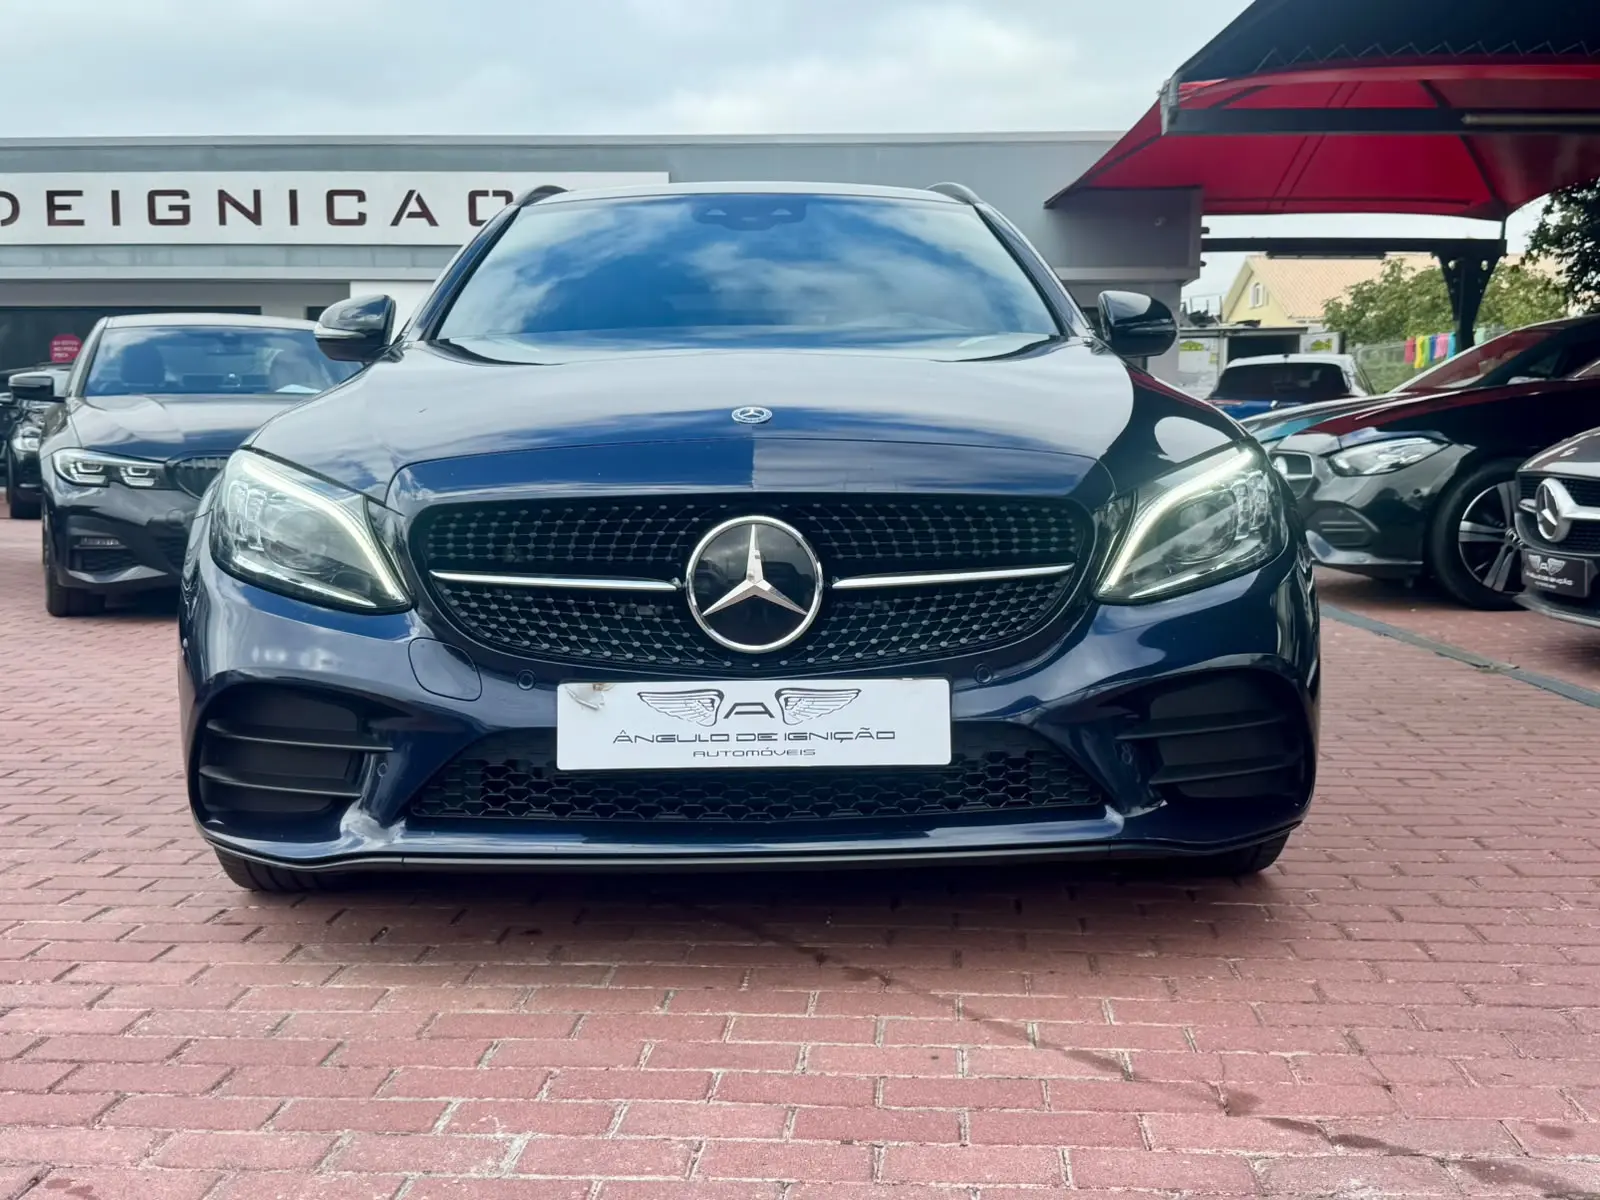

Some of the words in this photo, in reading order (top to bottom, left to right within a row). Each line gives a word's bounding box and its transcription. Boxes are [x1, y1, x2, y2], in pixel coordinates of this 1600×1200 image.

[723, 702, 775, 719] A
[613, 729, 730, 743] ÂNGULO
[736, 732, 778, 742] DE
[784, 727, 896, 743] IGNIÇÃO
